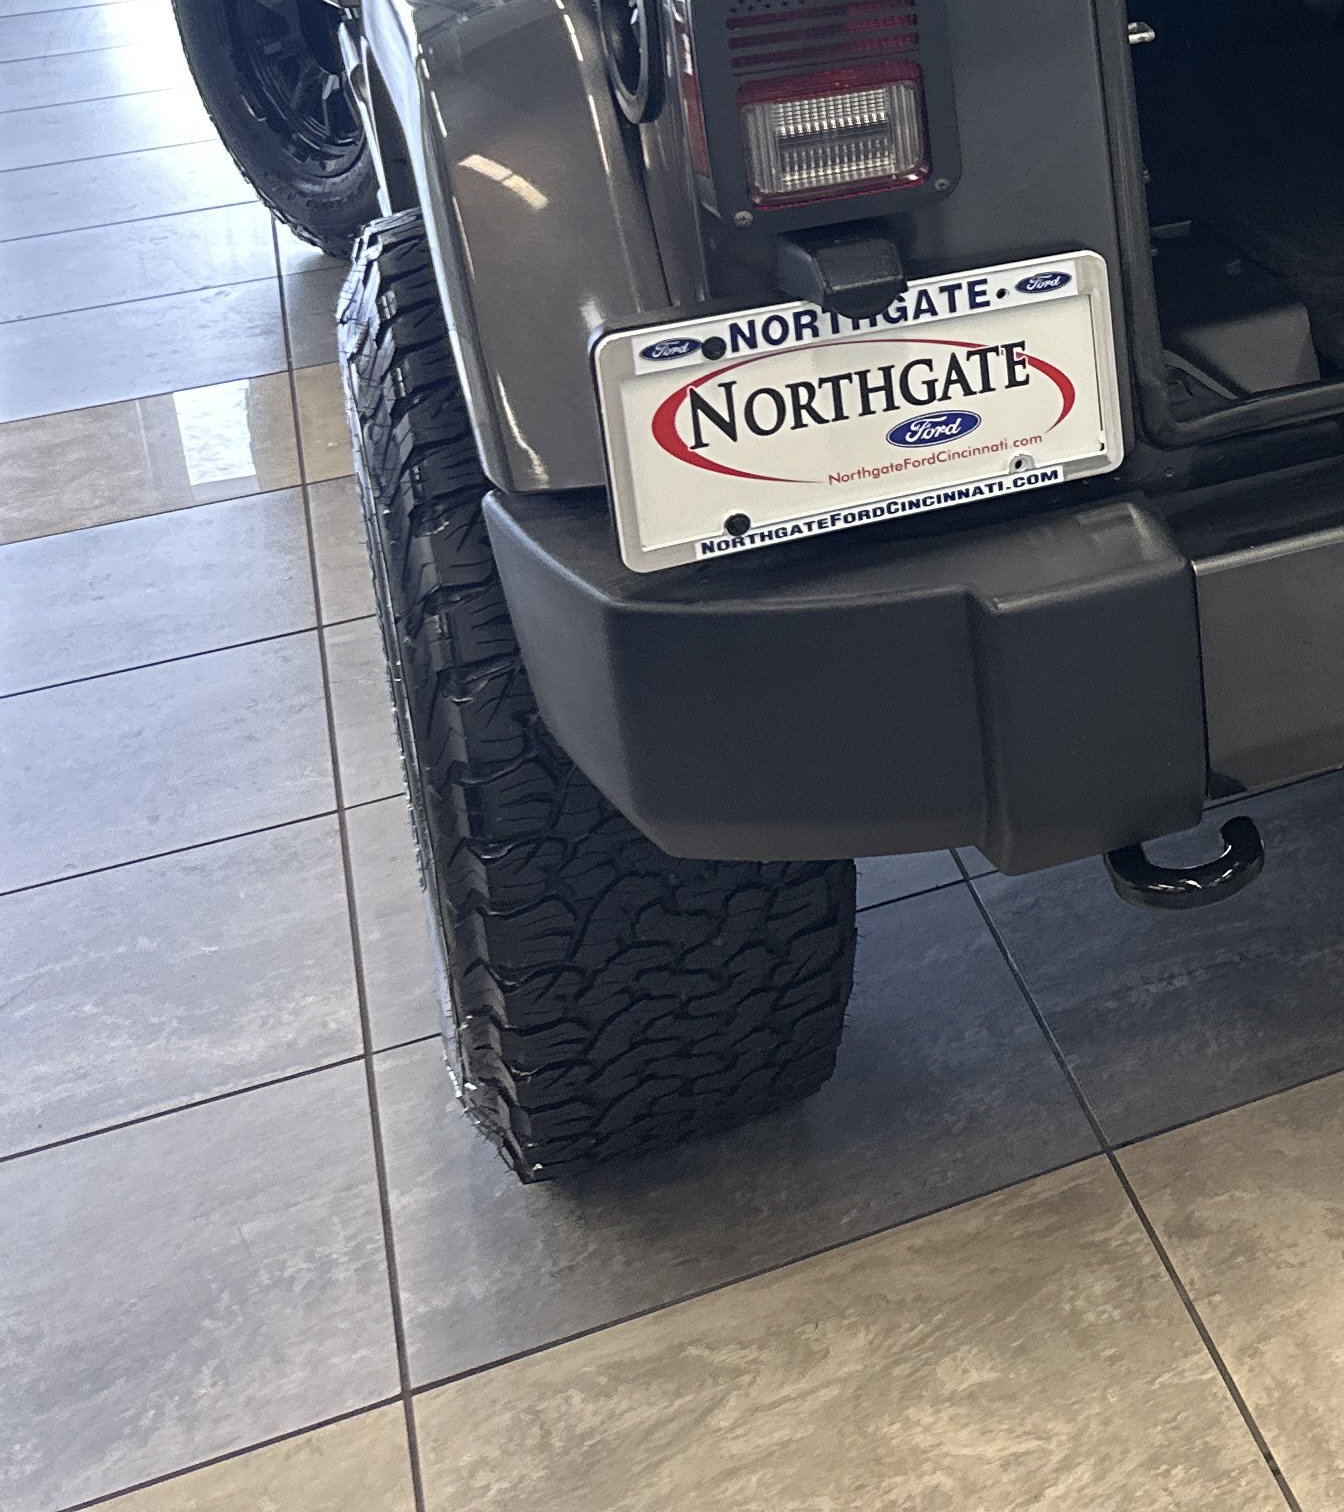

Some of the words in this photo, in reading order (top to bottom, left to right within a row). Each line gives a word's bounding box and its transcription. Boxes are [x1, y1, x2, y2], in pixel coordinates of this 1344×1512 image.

[651, 340, 690, 358] Ford
[1026, 274, 1061, 291] Ford
[687, 340, 1030, 451] NORTHGATE
[904, 415, 962, 443] Ford
[828, 433, 1043, 486] NorthgateFordCincinnati.com
